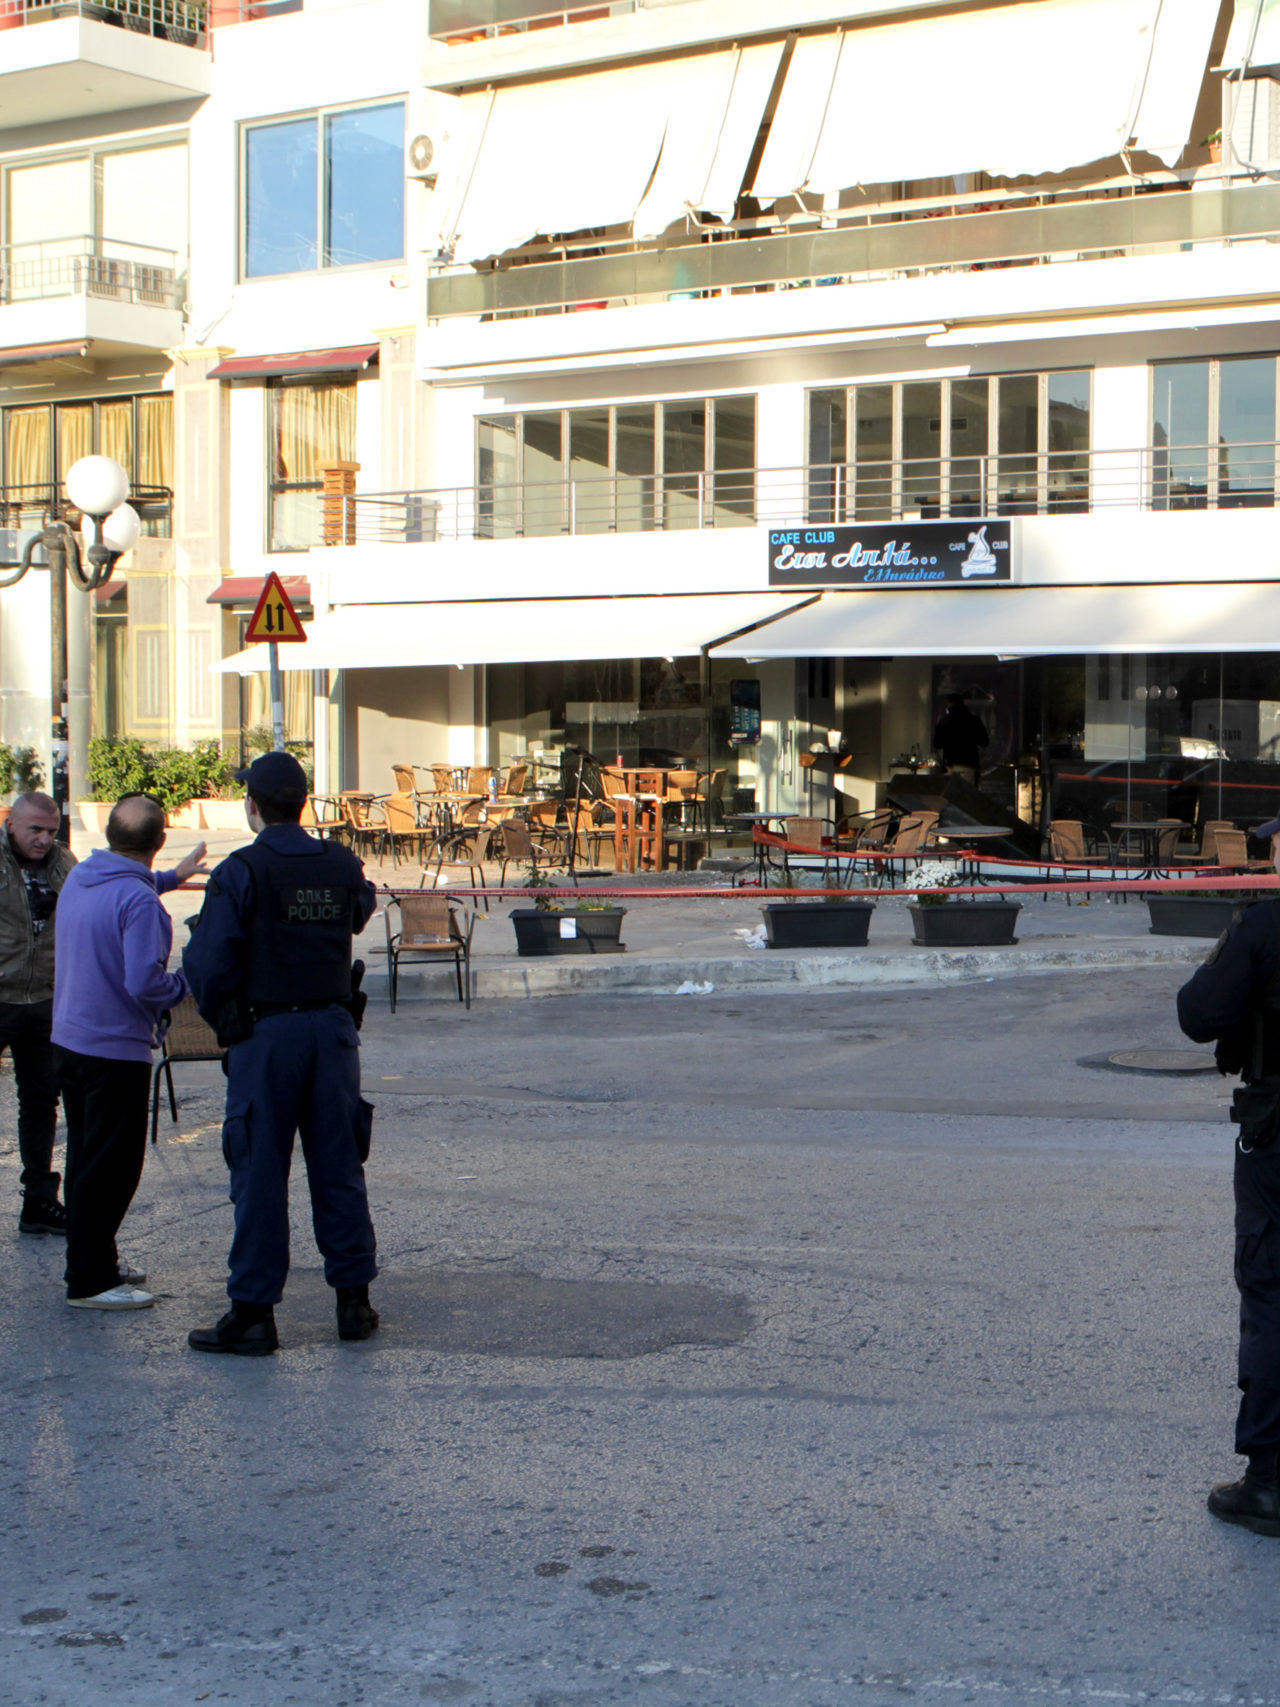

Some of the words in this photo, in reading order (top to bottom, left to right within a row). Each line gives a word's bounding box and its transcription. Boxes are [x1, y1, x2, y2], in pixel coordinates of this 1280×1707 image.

[771, 532, 801, 545] CAFE
[804, 530, 836, 544] CLUB
[288, 904, 342, 921] POLICE
